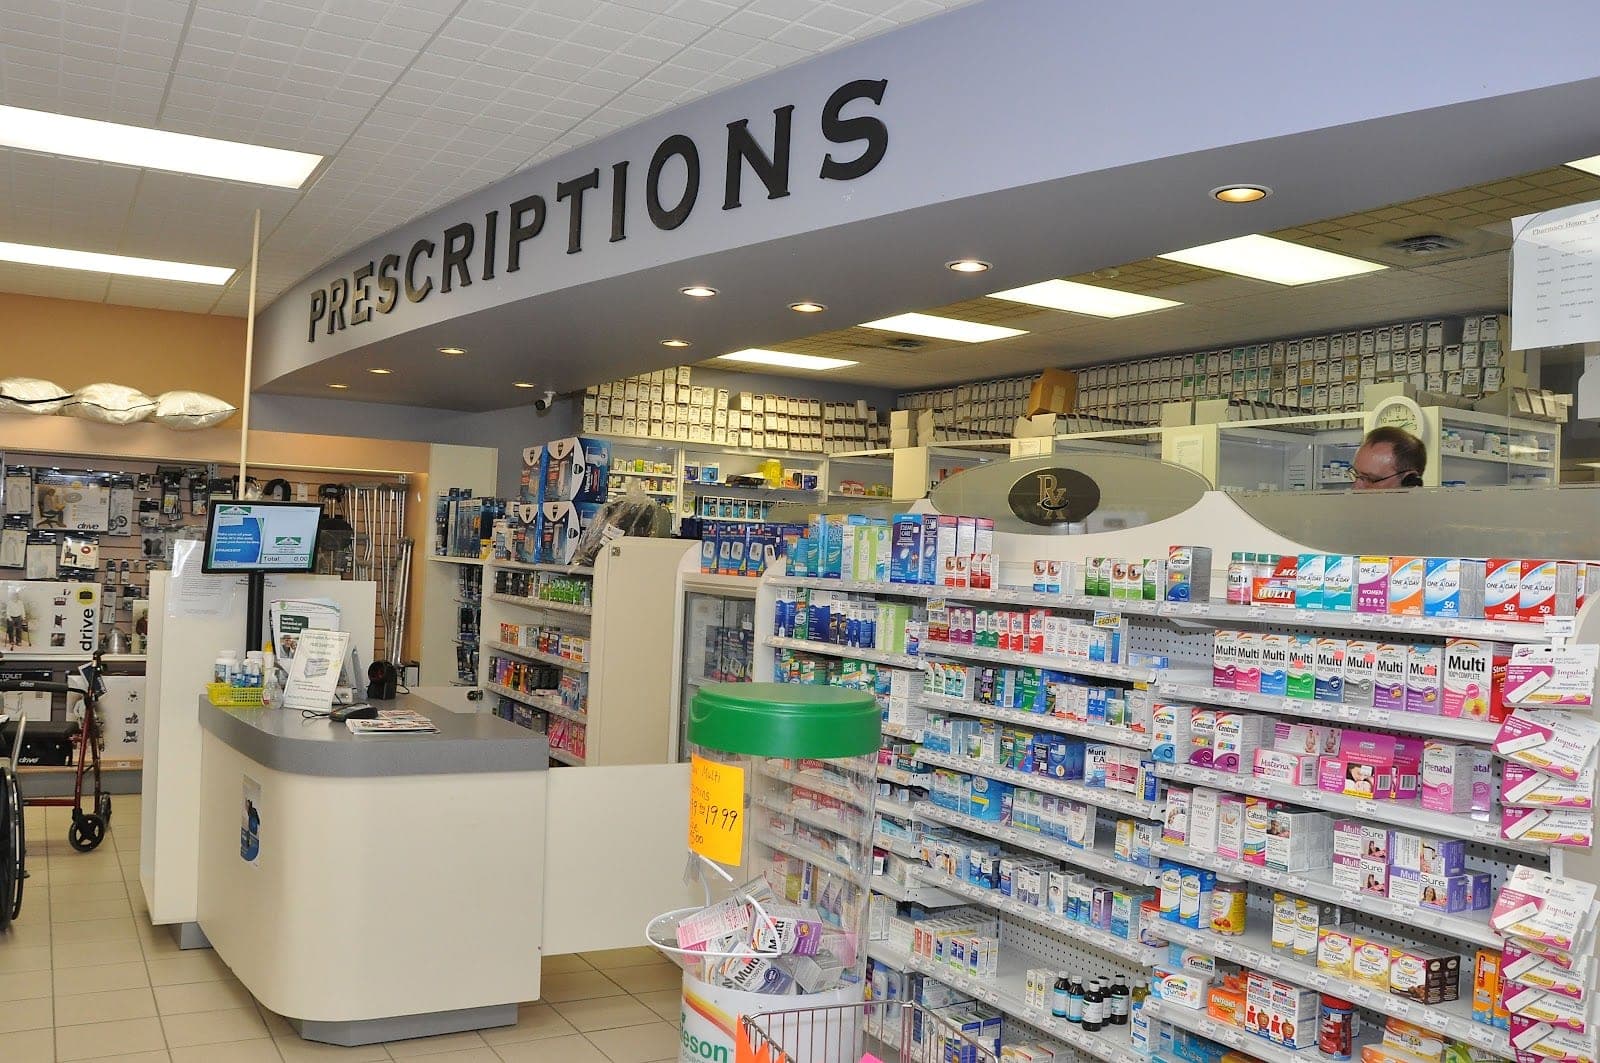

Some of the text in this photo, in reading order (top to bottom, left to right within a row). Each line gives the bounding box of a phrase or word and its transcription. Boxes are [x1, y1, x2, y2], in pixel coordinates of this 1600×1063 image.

[306, 78, 890, 343] PRESCRIPTIONS
[77, 522, 99, 530] drive
[1257, 588, 1293, 599] MULTI
[1443, 601, 1455, 609] 50
[1503, 603, 1515, 612] 50
[1539, 605, 1551, 614] 50
[79, 608, 94, 651] drive
[1215, 645, 1237, 657] Multi
[1237, 648, 1260, 659] Multi
[1262, 650, 1285, 661] Multi
[1377, 661, 1403, 673] Multi
[1448, 655, 1486, 672] Multi
[1459, 672, 1481, 680] COMPLETE
[1155, 717, 1175, 726] Centrum
[1193, 721, 1216, 730] Centrum
[1218, 725, 1239, 734] Centrum
[1260, 758, 1290, 771] Materna
[1297, 912, 1317, 923] Caltrate
[1190, 959, 1213, 971] Centrum
[1167, 981, 1187, 991] Centrum
